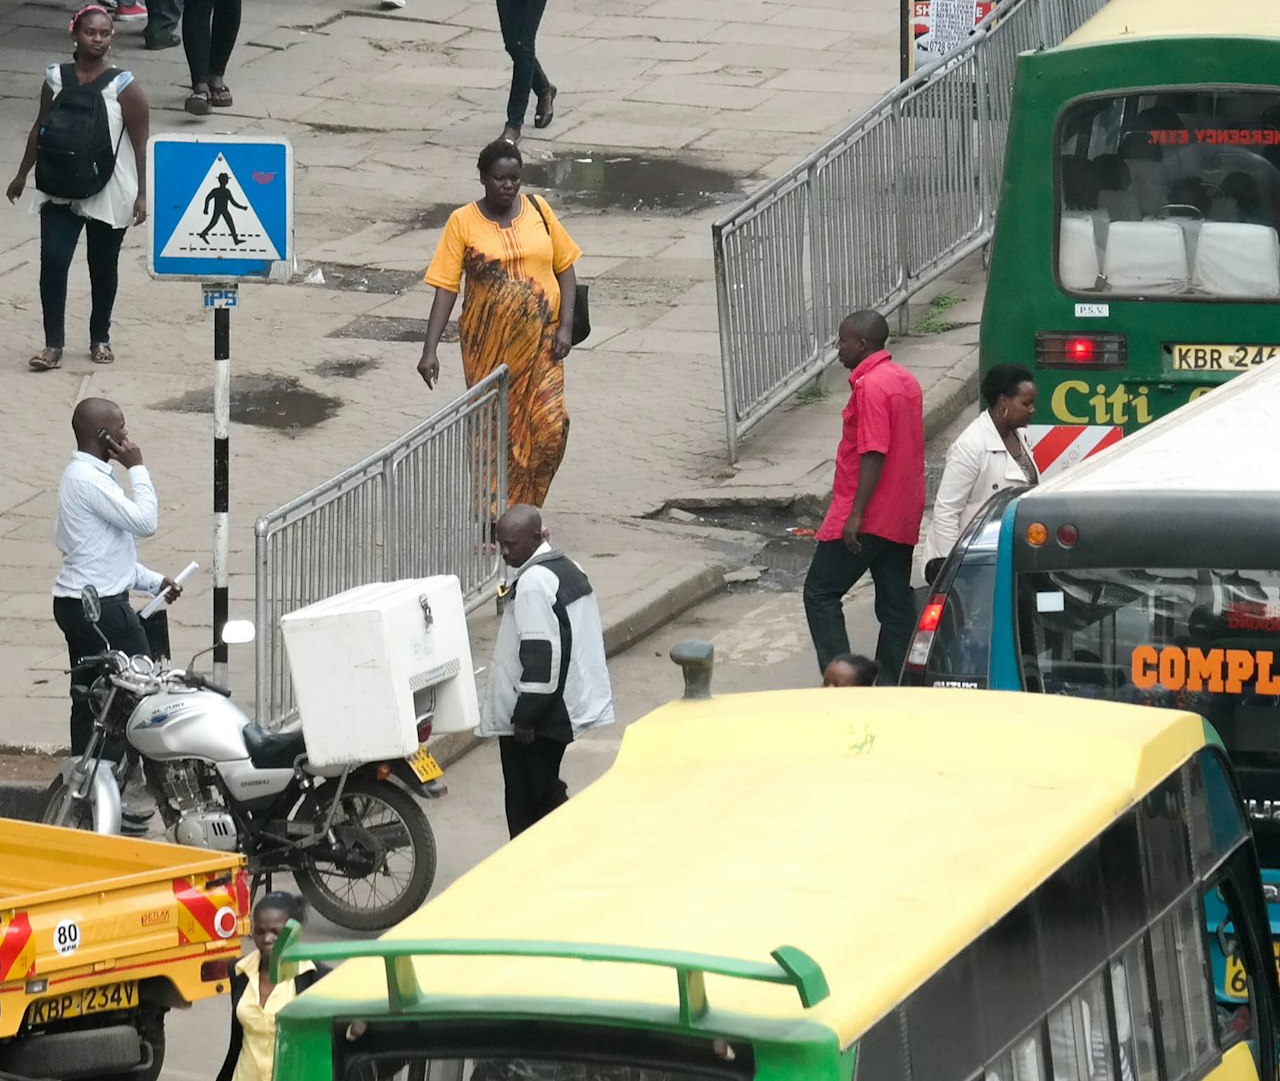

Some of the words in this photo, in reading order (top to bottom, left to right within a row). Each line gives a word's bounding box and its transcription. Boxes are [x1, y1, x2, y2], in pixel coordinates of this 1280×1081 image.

[1178, 347, 1223, 370] KBR
[1051, 380, 1153, 424] Citi
[58, 923, 77, 944] 80
[33, 997, 73, 1023] KBP
[86, 981, 135, 1011] 234V
